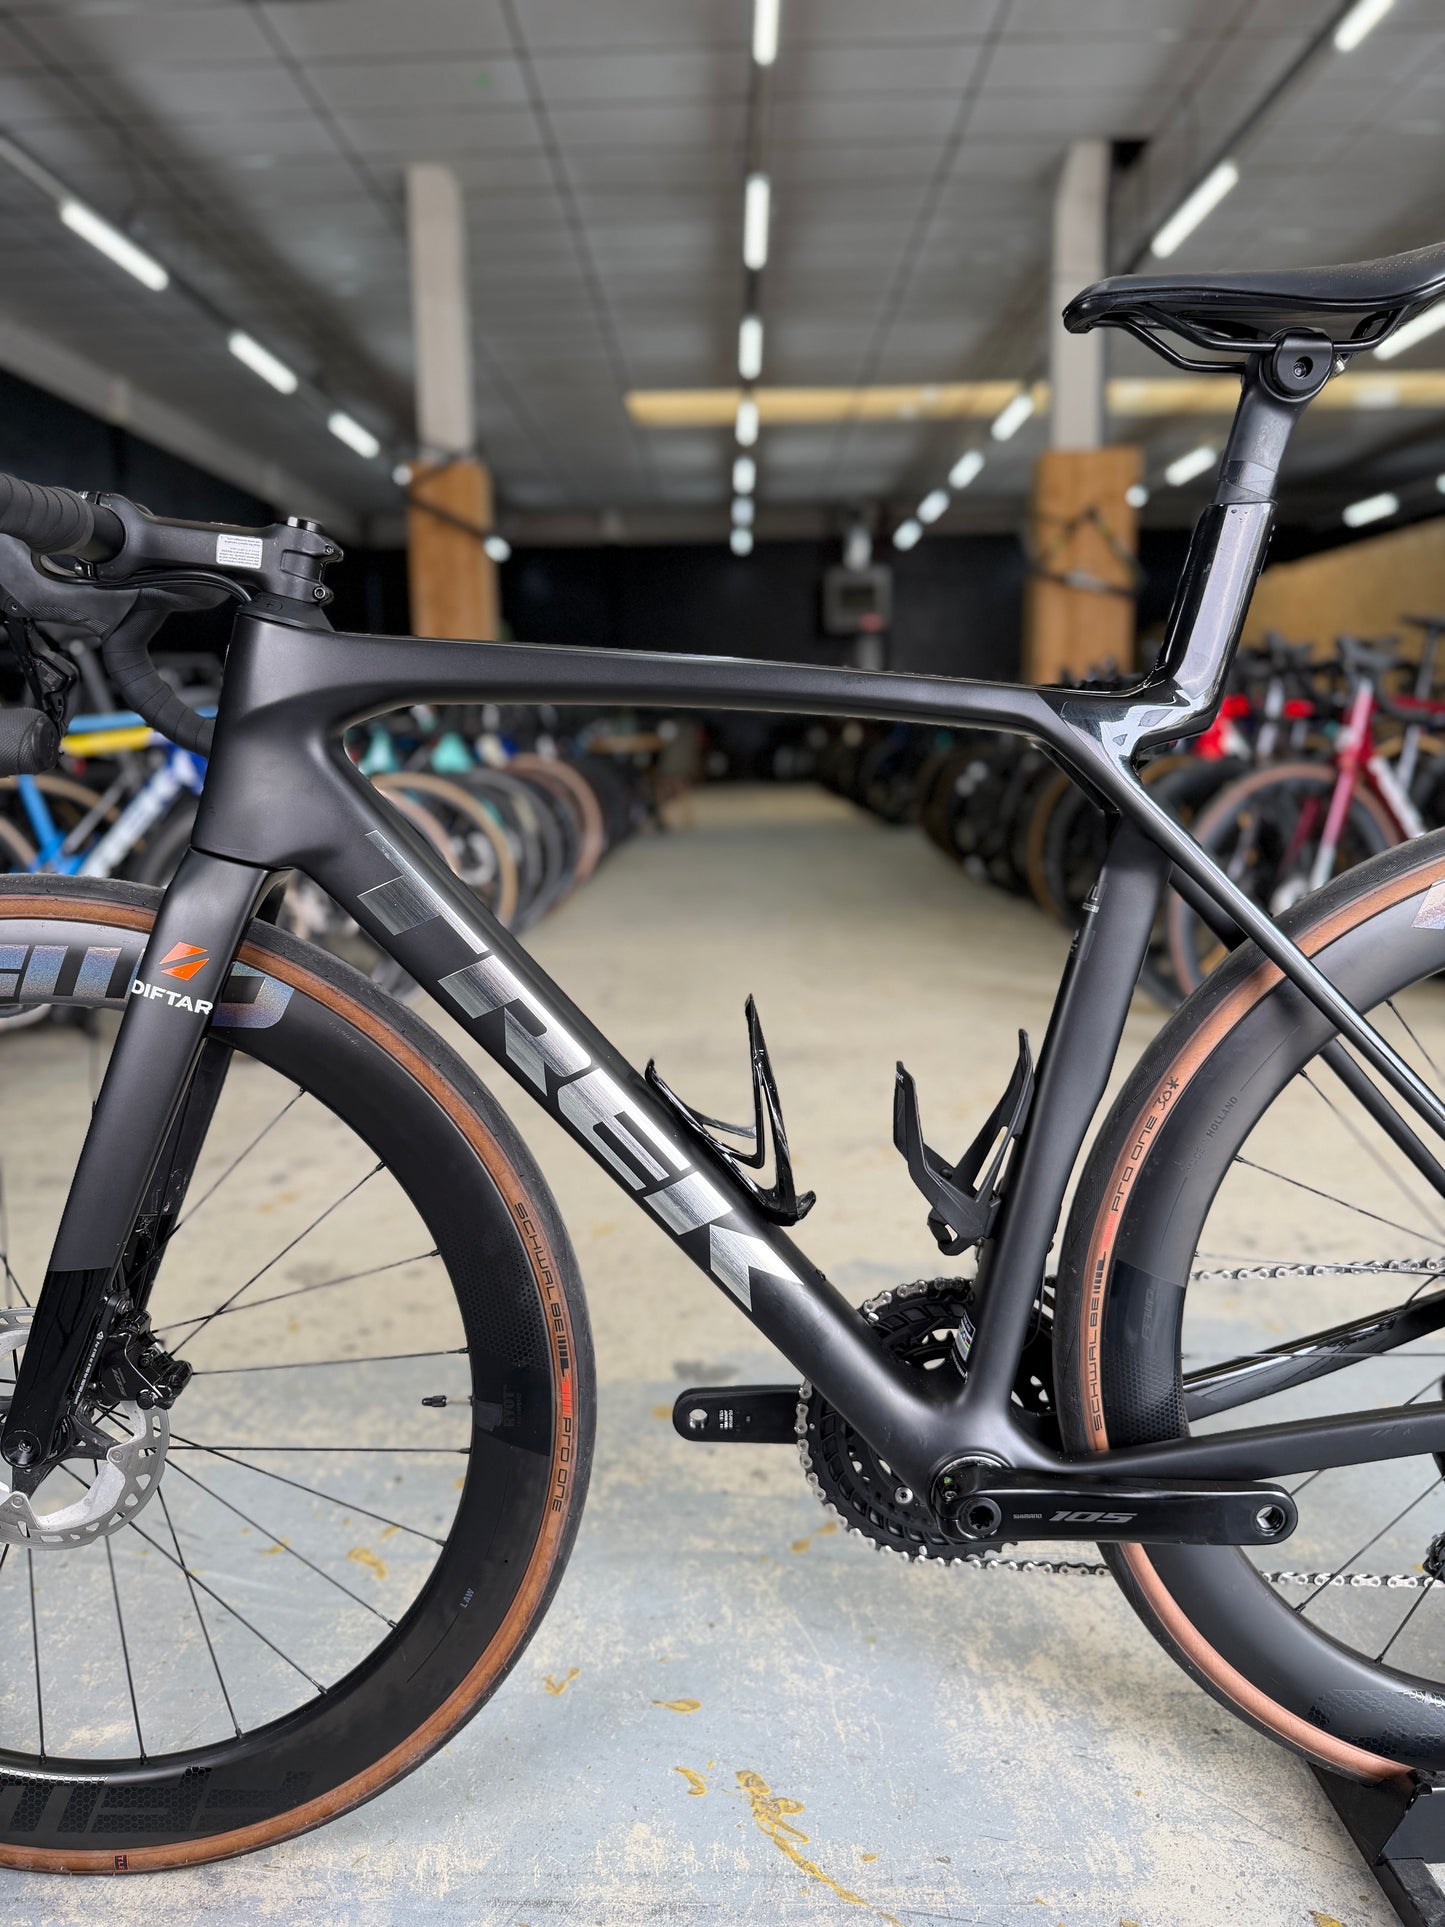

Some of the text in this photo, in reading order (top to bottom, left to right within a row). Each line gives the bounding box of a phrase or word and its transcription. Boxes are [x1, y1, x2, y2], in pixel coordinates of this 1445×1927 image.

[131, 979, 214, 1015] DIFTAR
[357, 830, 803, 1312] TREK
[1206, 1096, 1239, 1138] HOLLAND
[514, 1202, 564, 1332] SCHWALBE
[1088, 1297, 1103, 1431] SCHWALBE
[1048, 1510, 1138, 1523] 105
